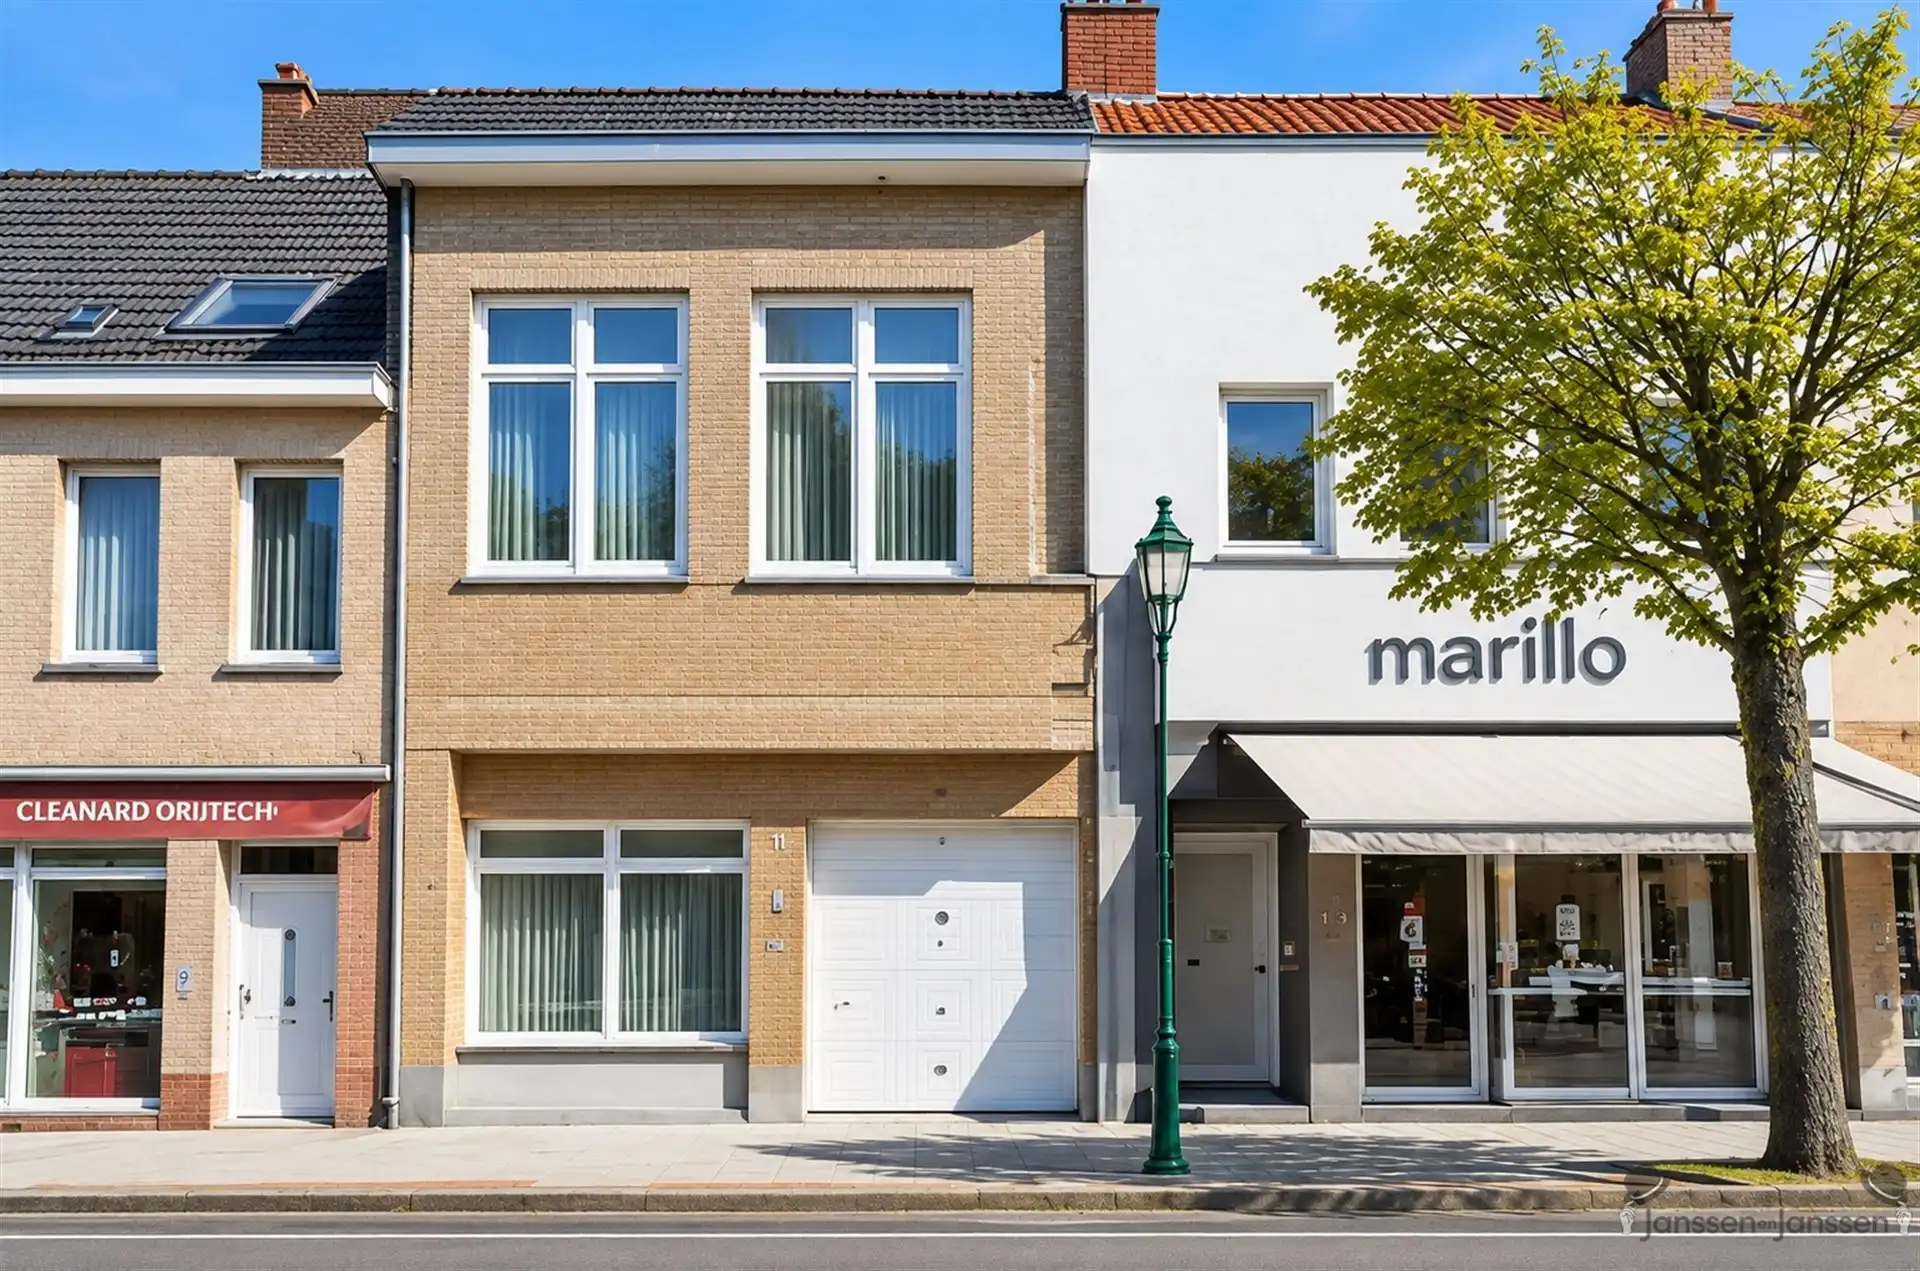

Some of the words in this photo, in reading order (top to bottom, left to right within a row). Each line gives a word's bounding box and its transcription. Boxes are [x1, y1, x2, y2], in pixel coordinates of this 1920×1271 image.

[1364, 616, 1627, 686] marillo
[16, 801, 150, 822] CLEANARD
[771, 832, 786, 850] 11
[179, 970, 189, 985] 9
